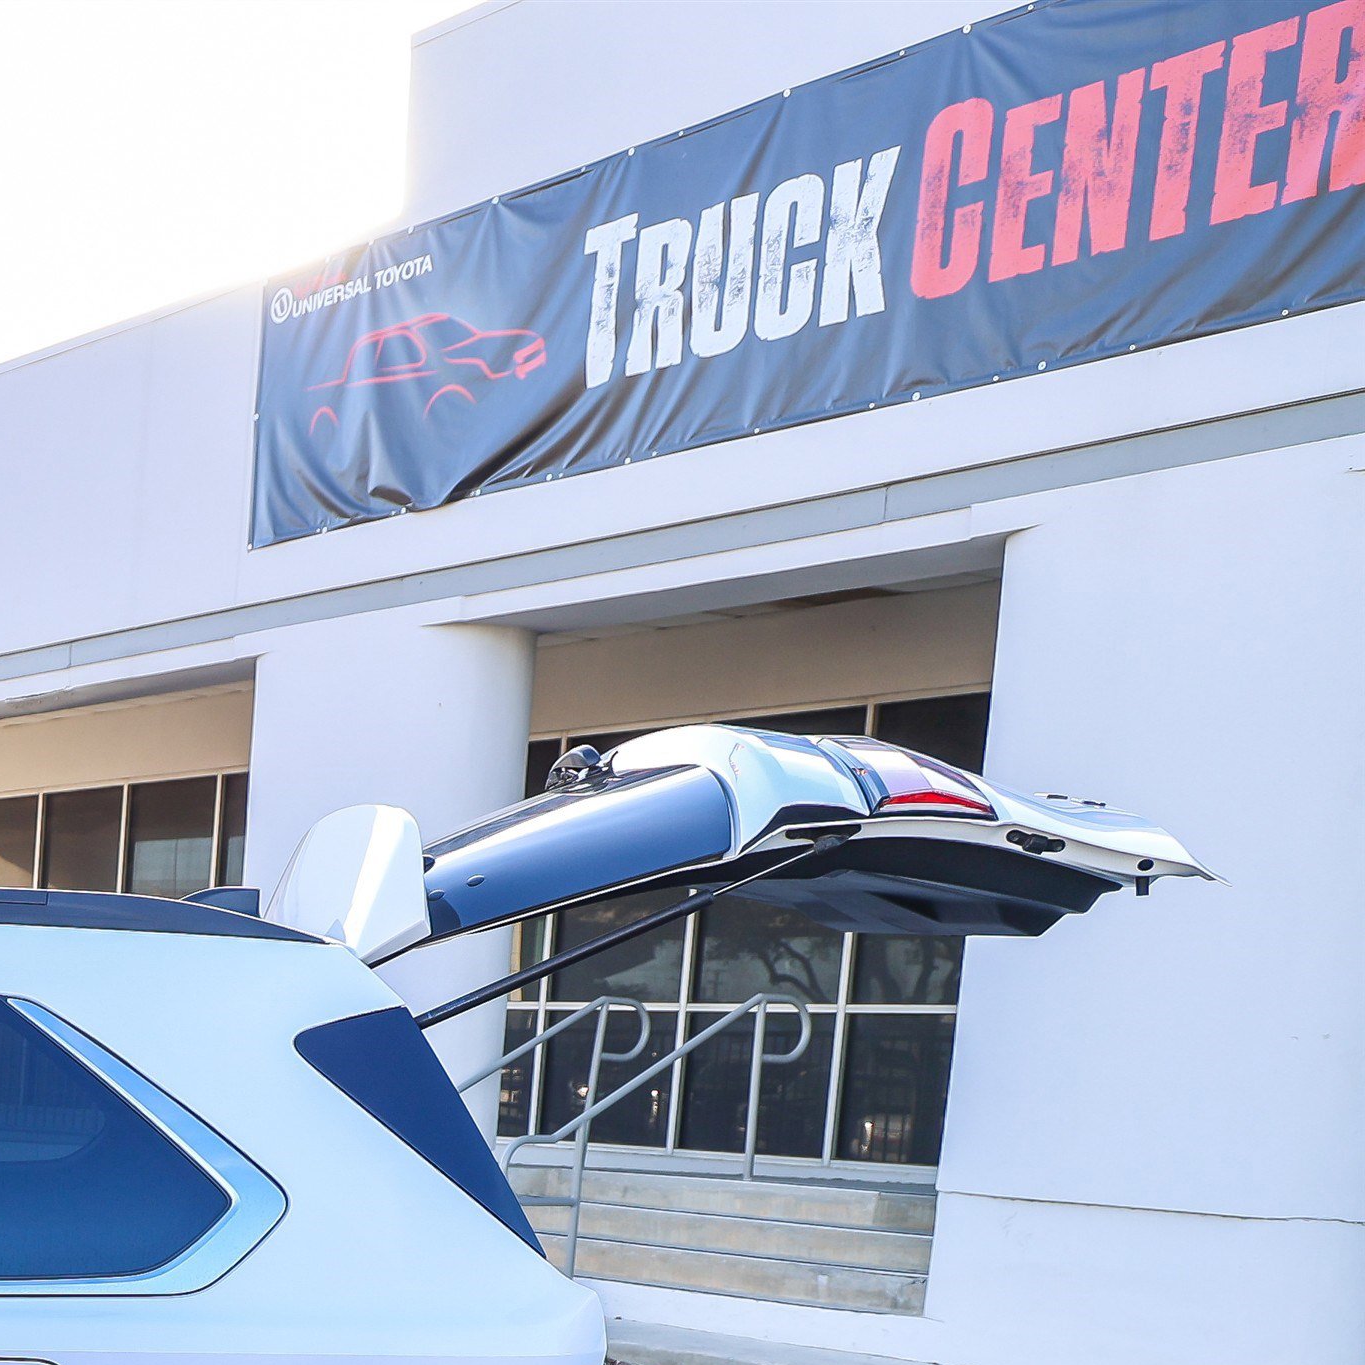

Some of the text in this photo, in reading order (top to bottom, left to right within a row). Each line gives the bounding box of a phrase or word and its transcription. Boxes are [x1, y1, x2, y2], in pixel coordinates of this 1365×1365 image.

[292, 254, 433, 318] UNIVERSAL TOYOTA
[583, 0, 1365, 390] TRUCK CENTER
